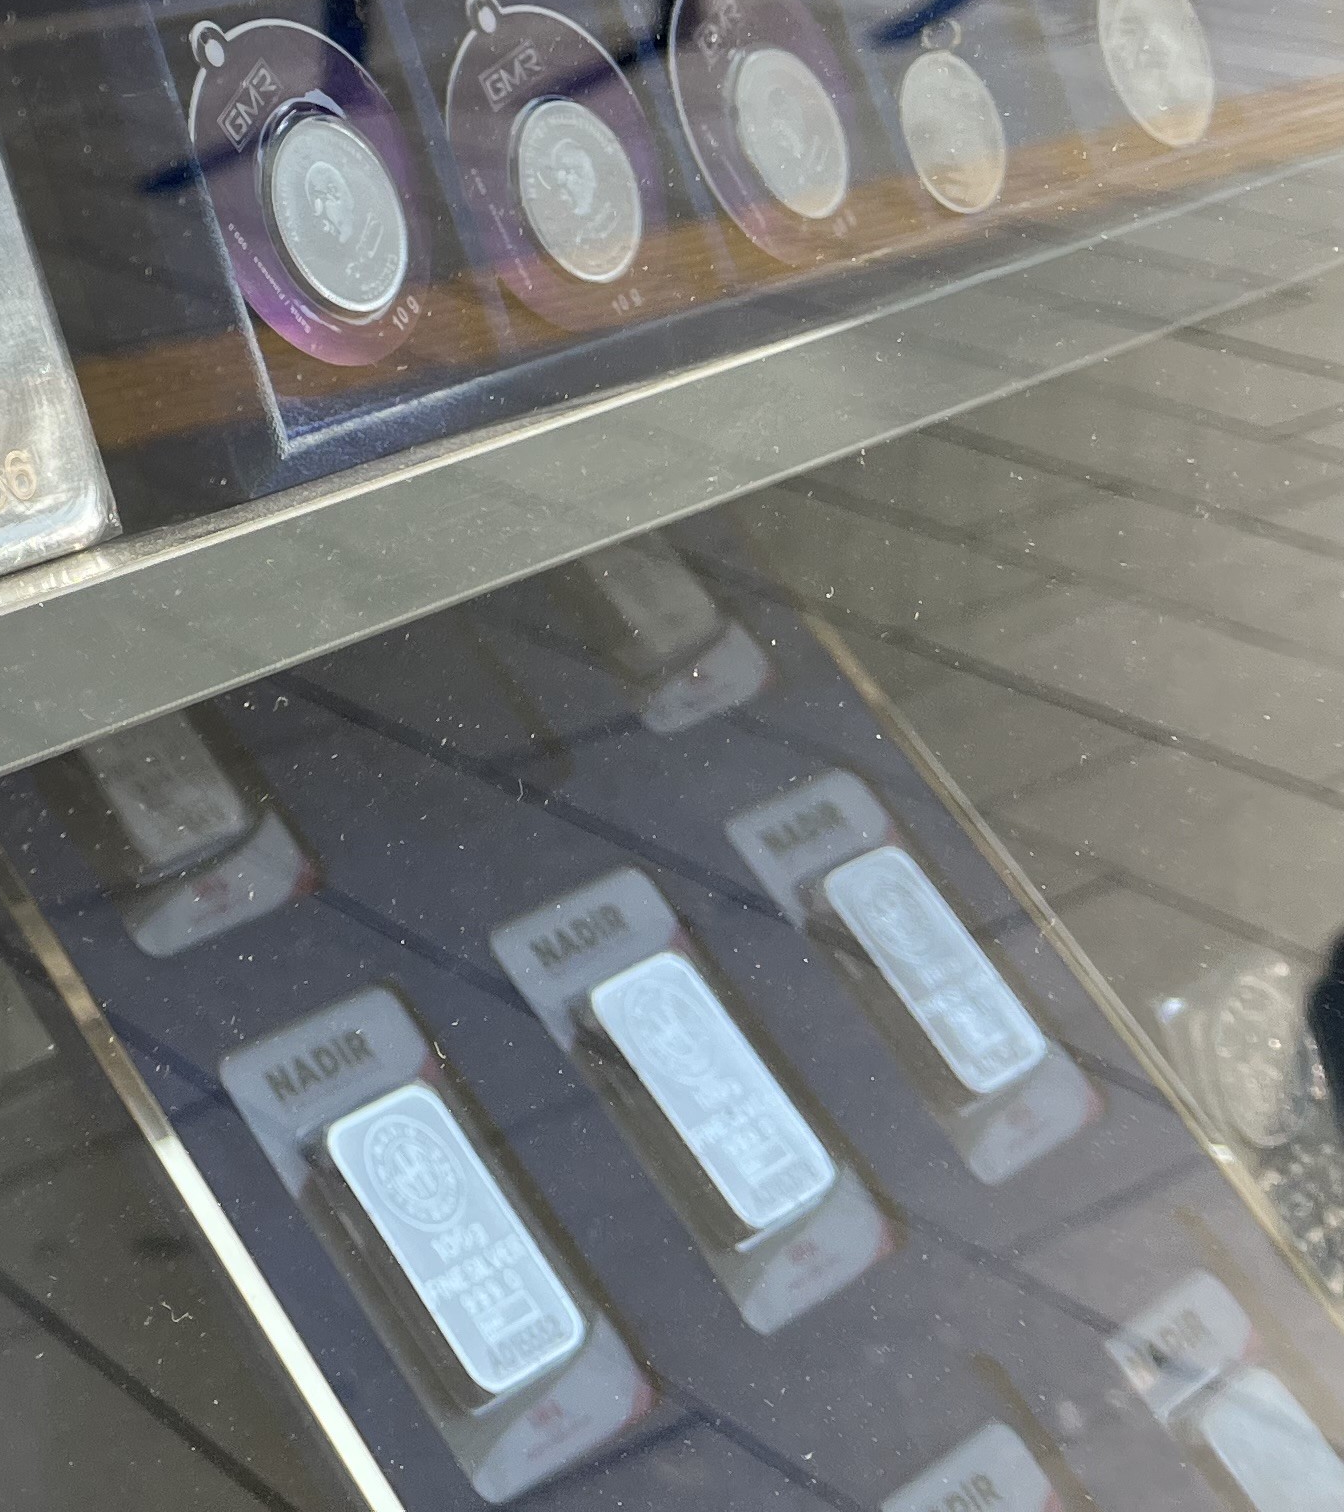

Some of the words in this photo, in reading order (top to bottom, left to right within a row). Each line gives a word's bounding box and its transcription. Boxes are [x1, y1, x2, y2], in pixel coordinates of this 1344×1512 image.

[226, 68, 278, 143] GMR
[528, 903, 631, 968] NADIR
[264, 1029, 376, 1104] NADIR
